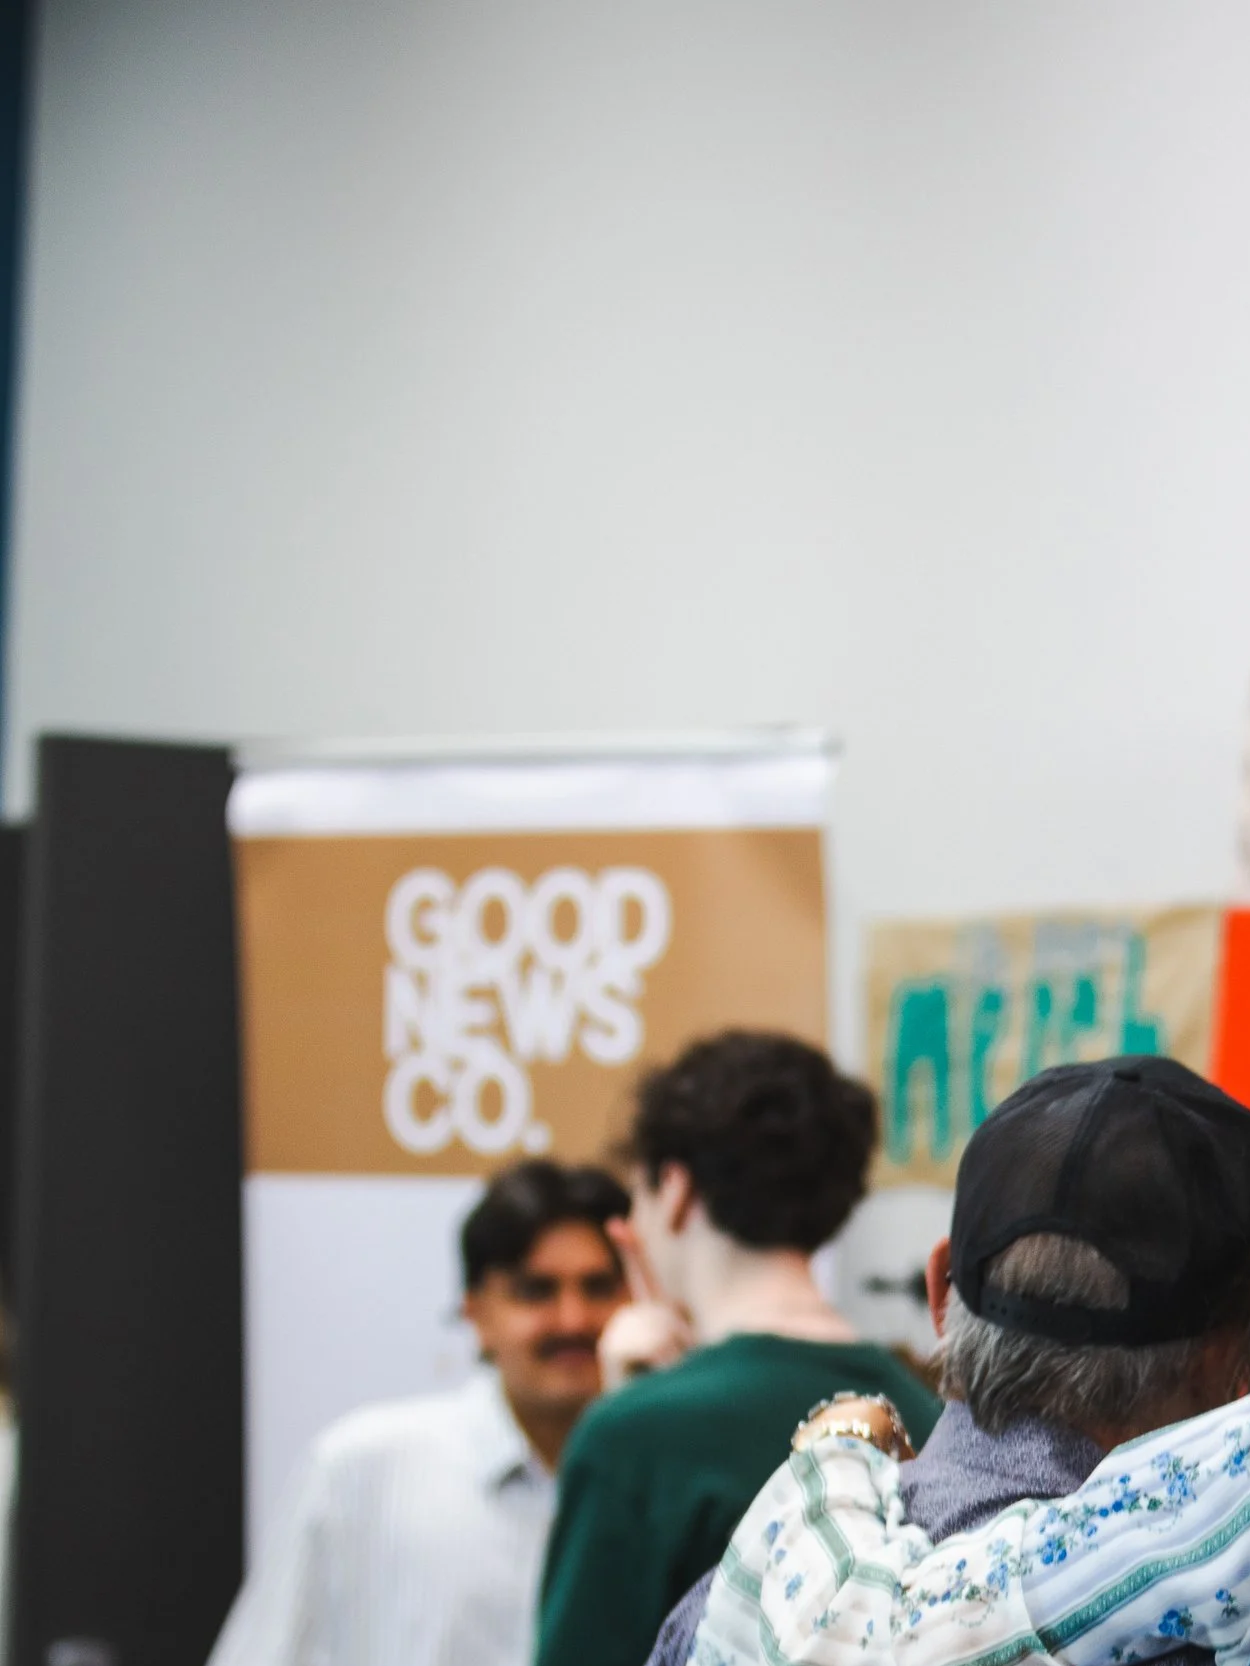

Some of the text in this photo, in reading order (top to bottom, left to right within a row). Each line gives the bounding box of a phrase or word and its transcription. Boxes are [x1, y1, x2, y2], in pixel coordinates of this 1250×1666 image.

[385, 866, 671, 972] GOOD
[383, 960, 643, 1064] NEWS
[382, 1050, 553, 1155] CO.
